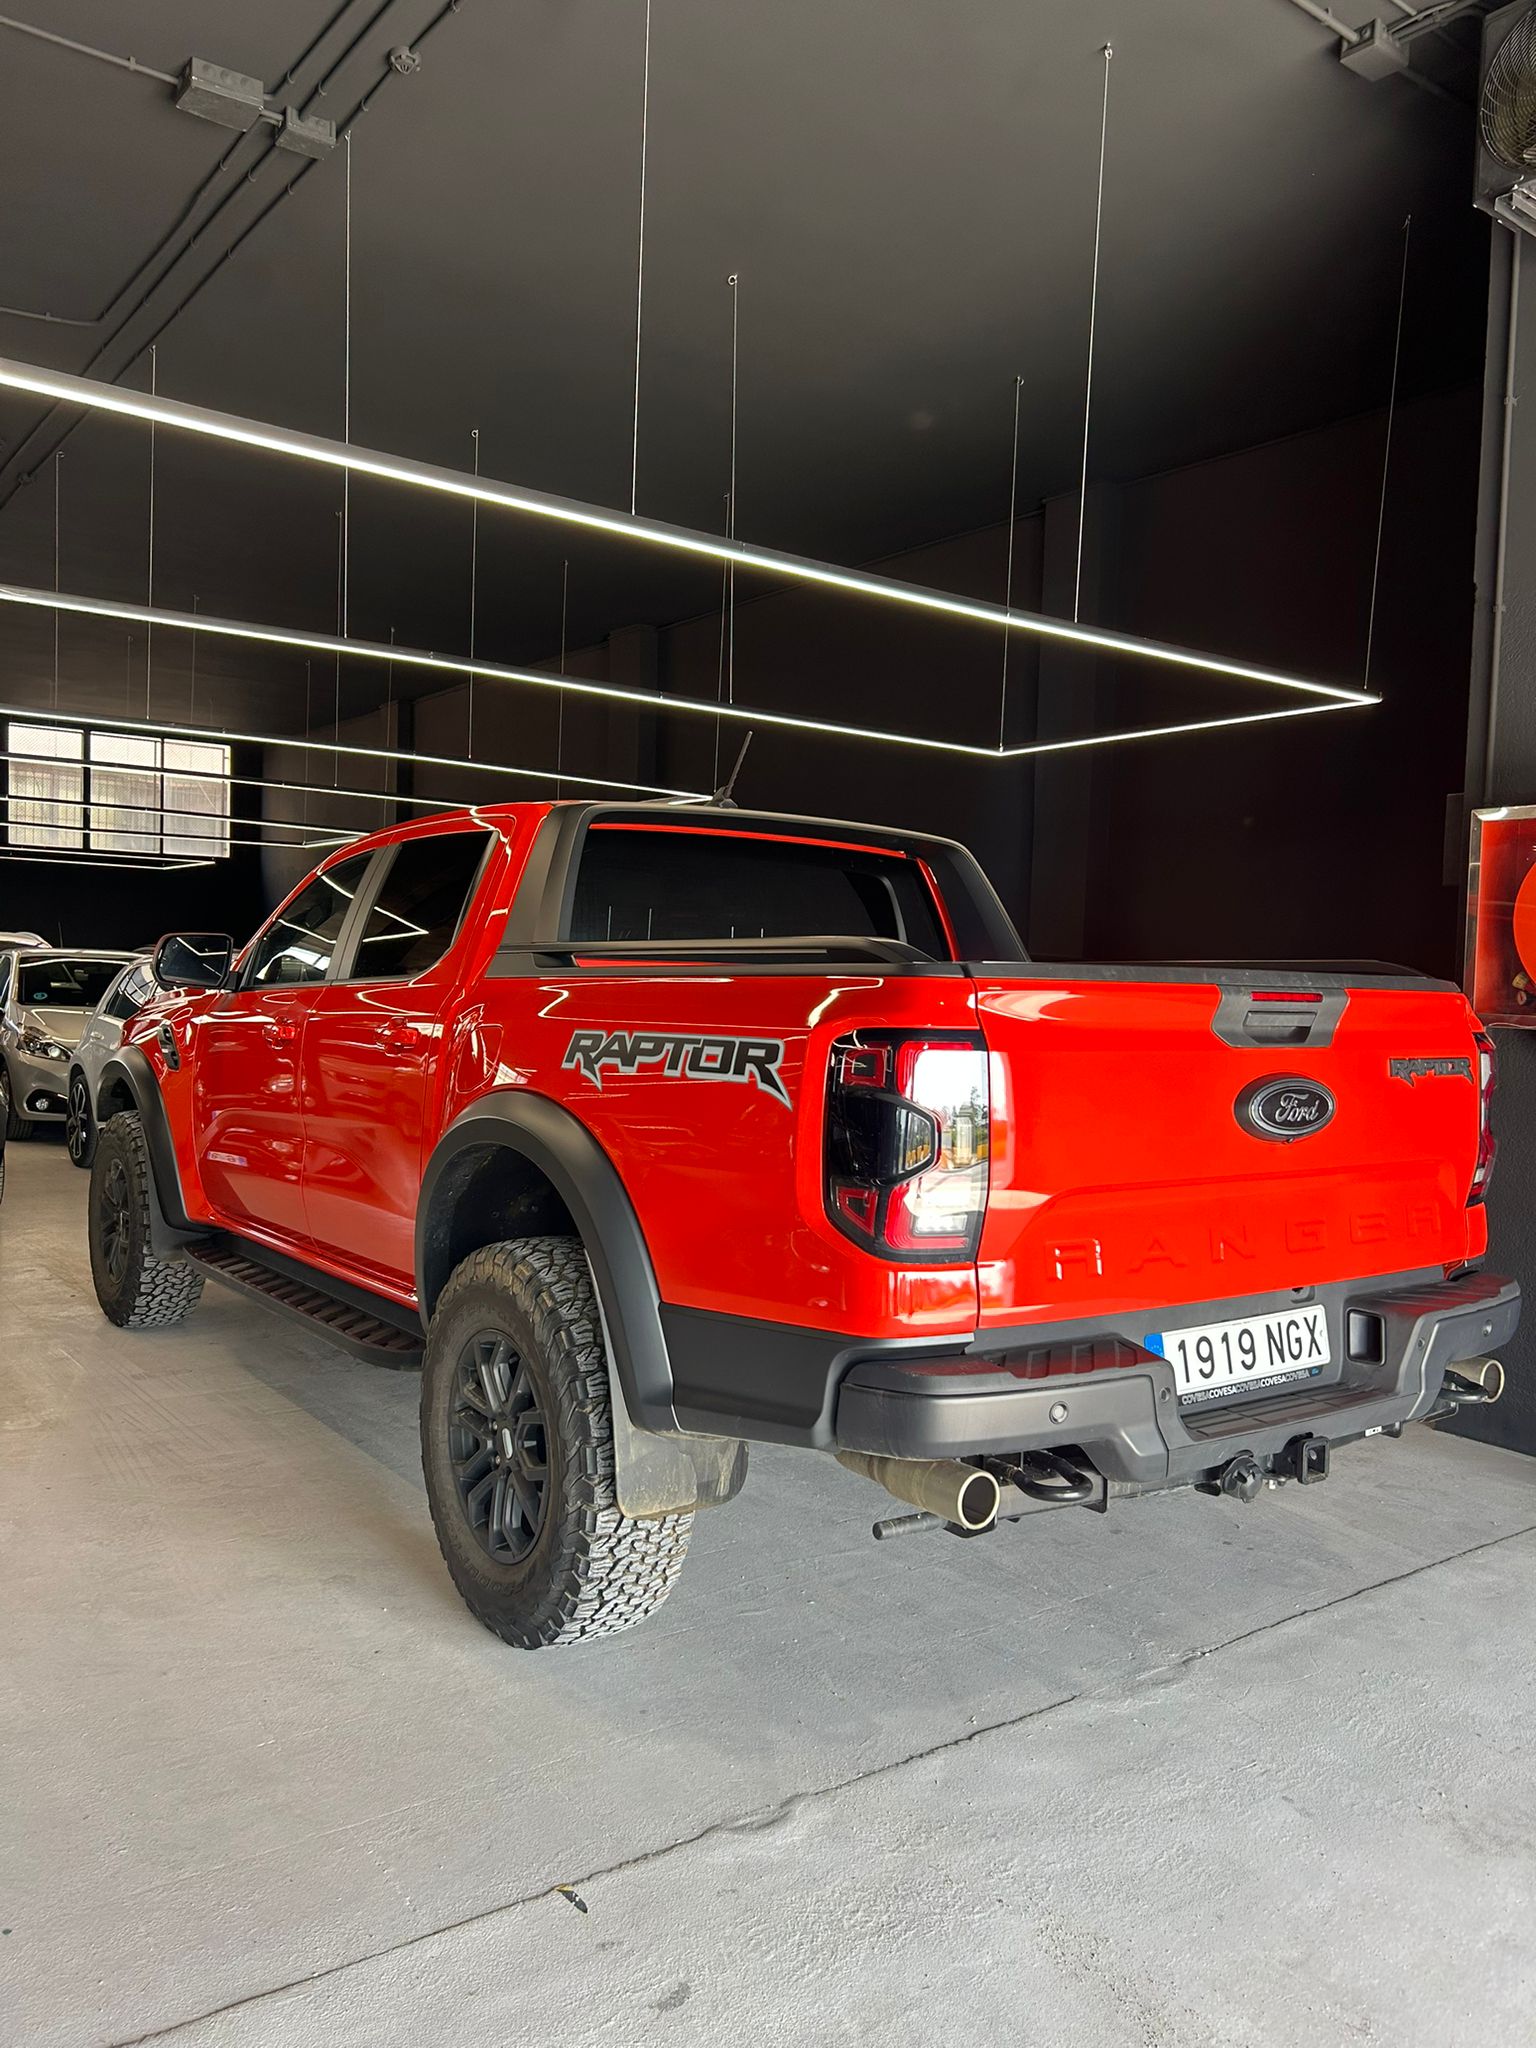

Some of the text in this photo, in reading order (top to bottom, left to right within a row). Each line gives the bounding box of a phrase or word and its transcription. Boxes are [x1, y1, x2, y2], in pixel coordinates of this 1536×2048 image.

[561, 1029, 793, 1112] RAPTOR
[1389, 1057, 1474, 1087] RAPTOR
[1275, 1093, 1320, 1122] Ford
[1044, 1203, 1442, 1281] RANGER
[1178, 1315, 1322, 1383] 1919 NGX
